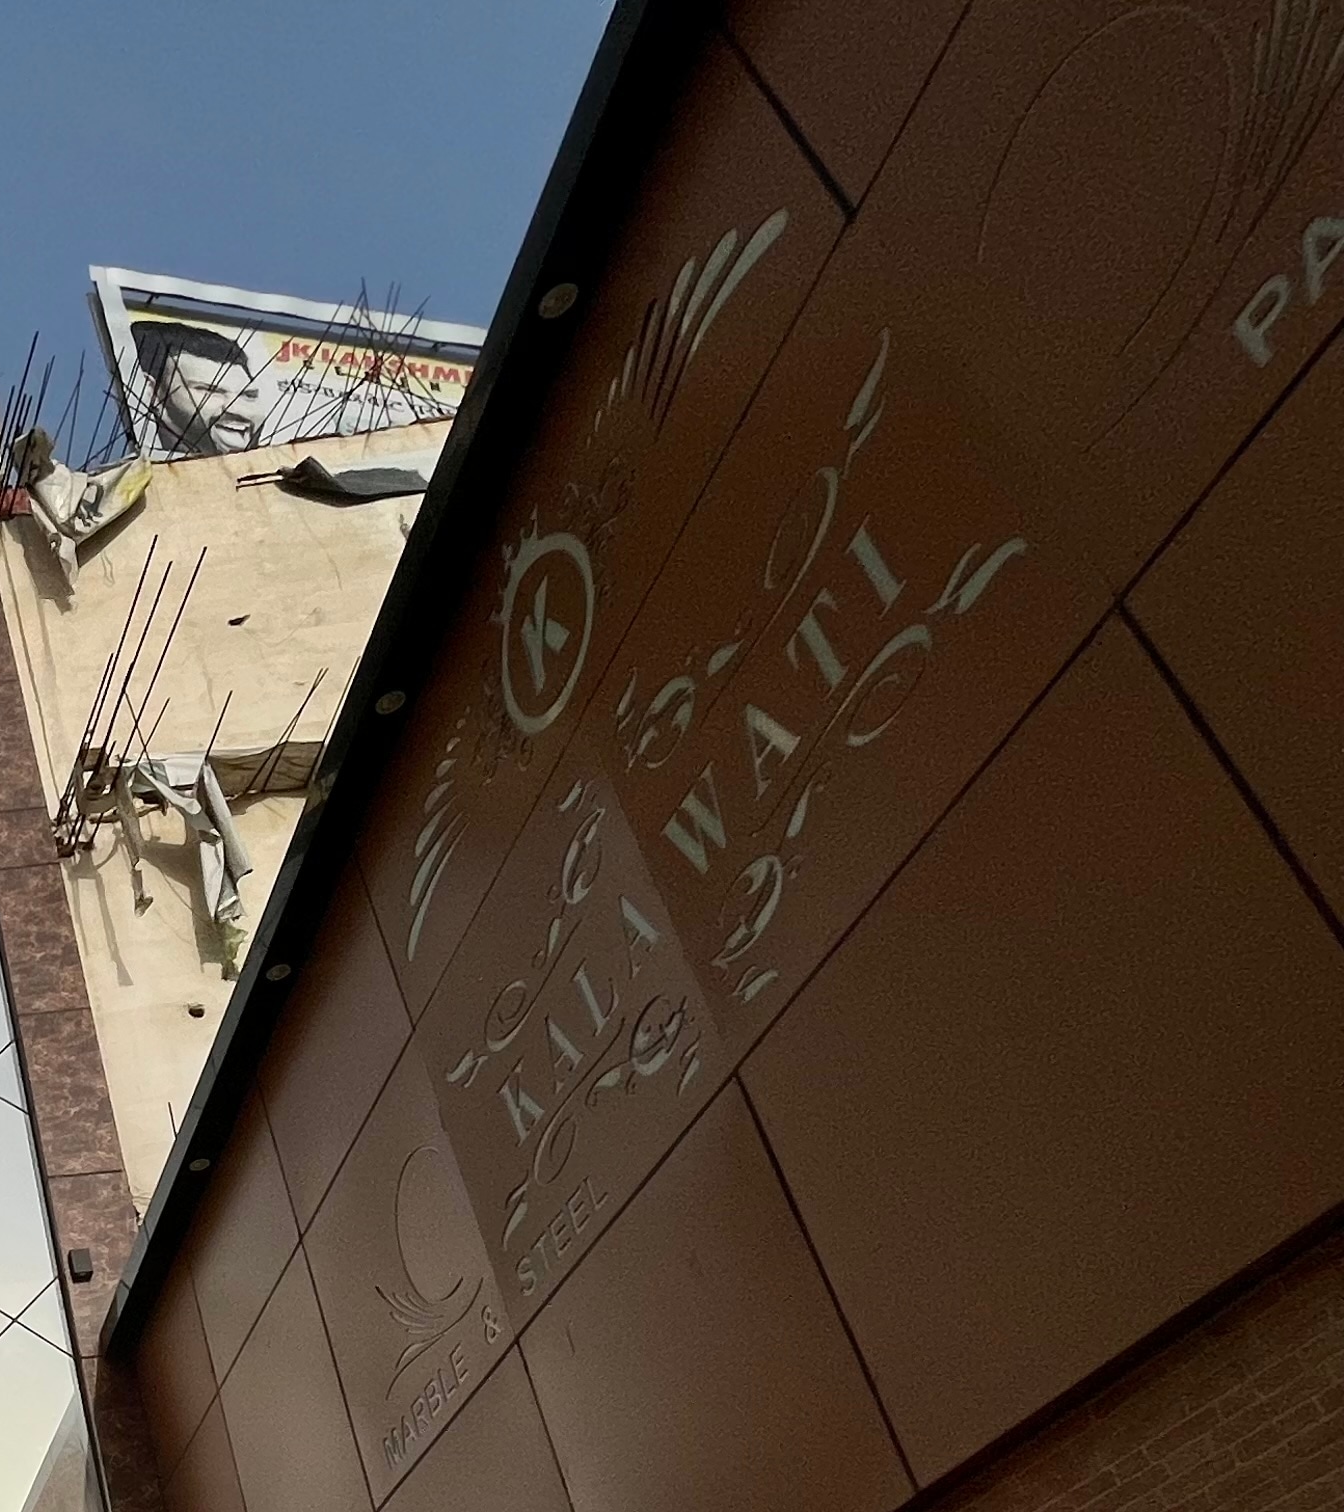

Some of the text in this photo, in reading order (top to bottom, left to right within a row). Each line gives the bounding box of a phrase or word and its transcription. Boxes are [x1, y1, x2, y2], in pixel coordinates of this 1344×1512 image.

[275, 341, 312, 363] JK
[384, 1355, 470, 1471] MARBLE
[516, 1175, 610, 1298] STEEL
